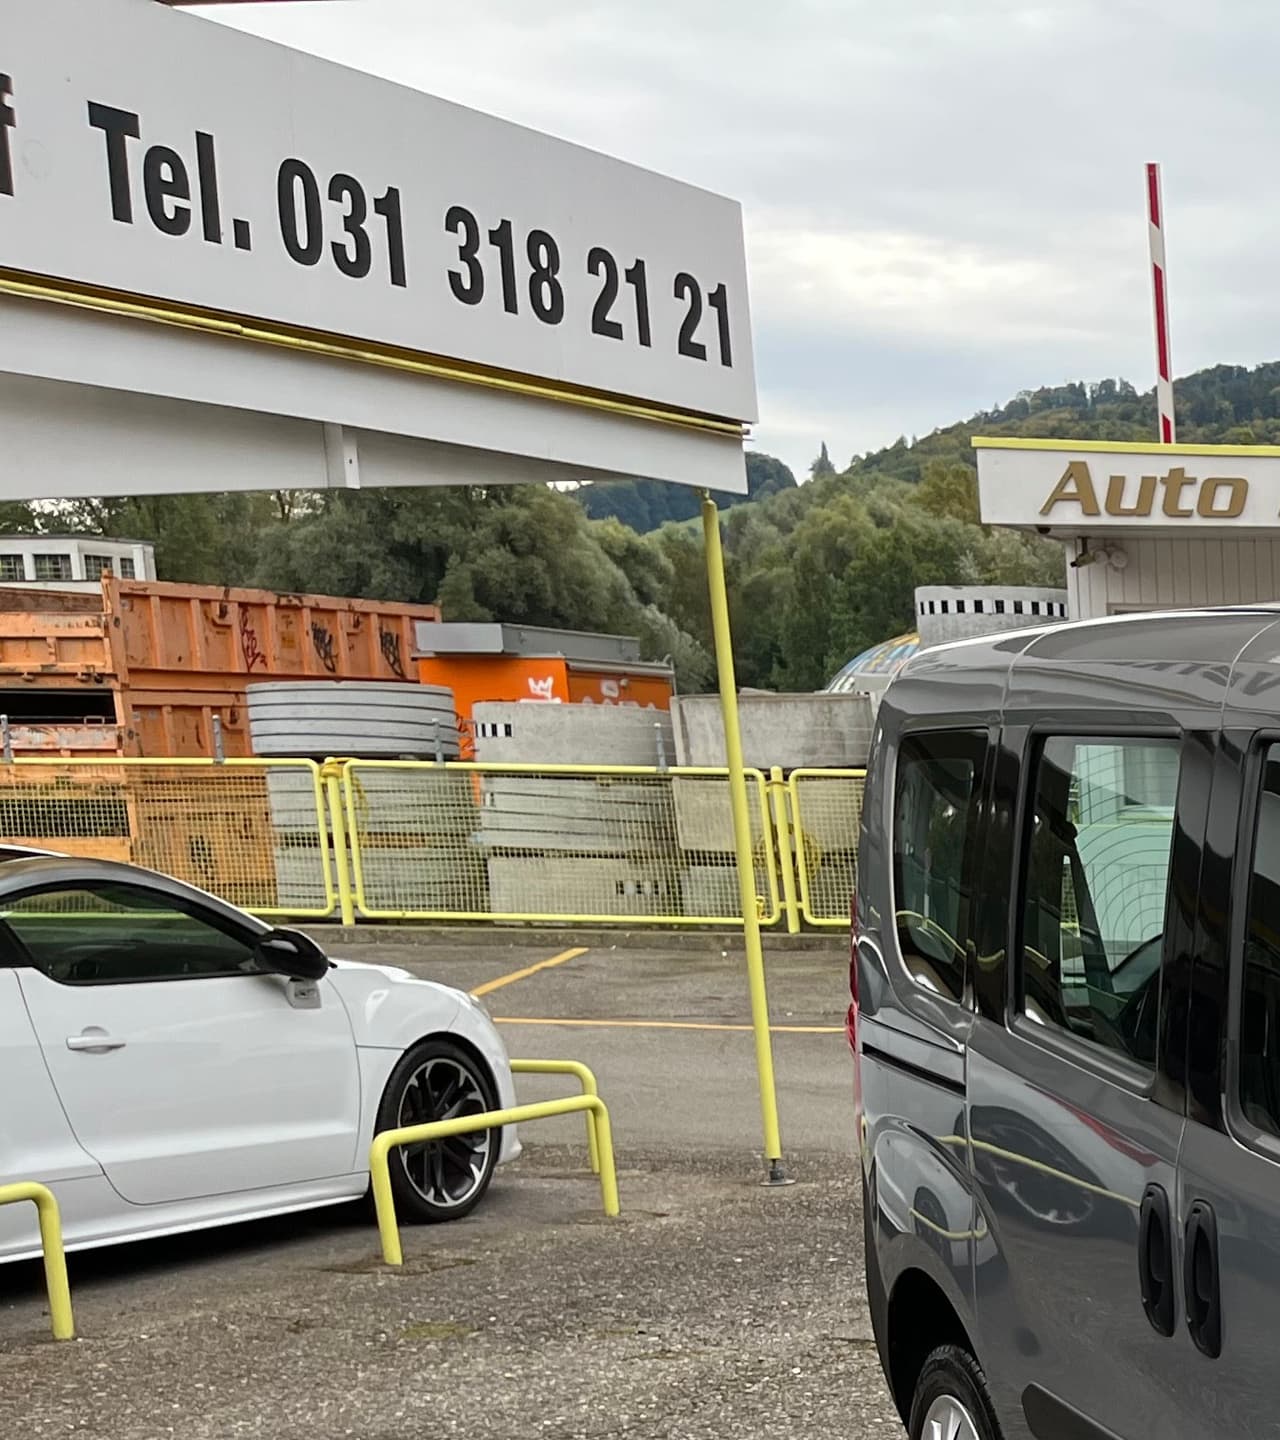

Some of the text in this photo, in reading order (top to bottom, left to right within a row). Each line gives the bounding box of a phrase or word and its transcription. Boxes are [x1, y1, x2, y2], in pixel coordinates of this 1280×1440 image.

[87, 100, 252, 252] Tel.
[277, 157, 408, 289] 031
[444, 205, 565, 326] 318
[588, 247, 652, 349] 21
[673, 272, 733, 368] 21
[1038, 459, 1250, 519] Auto
